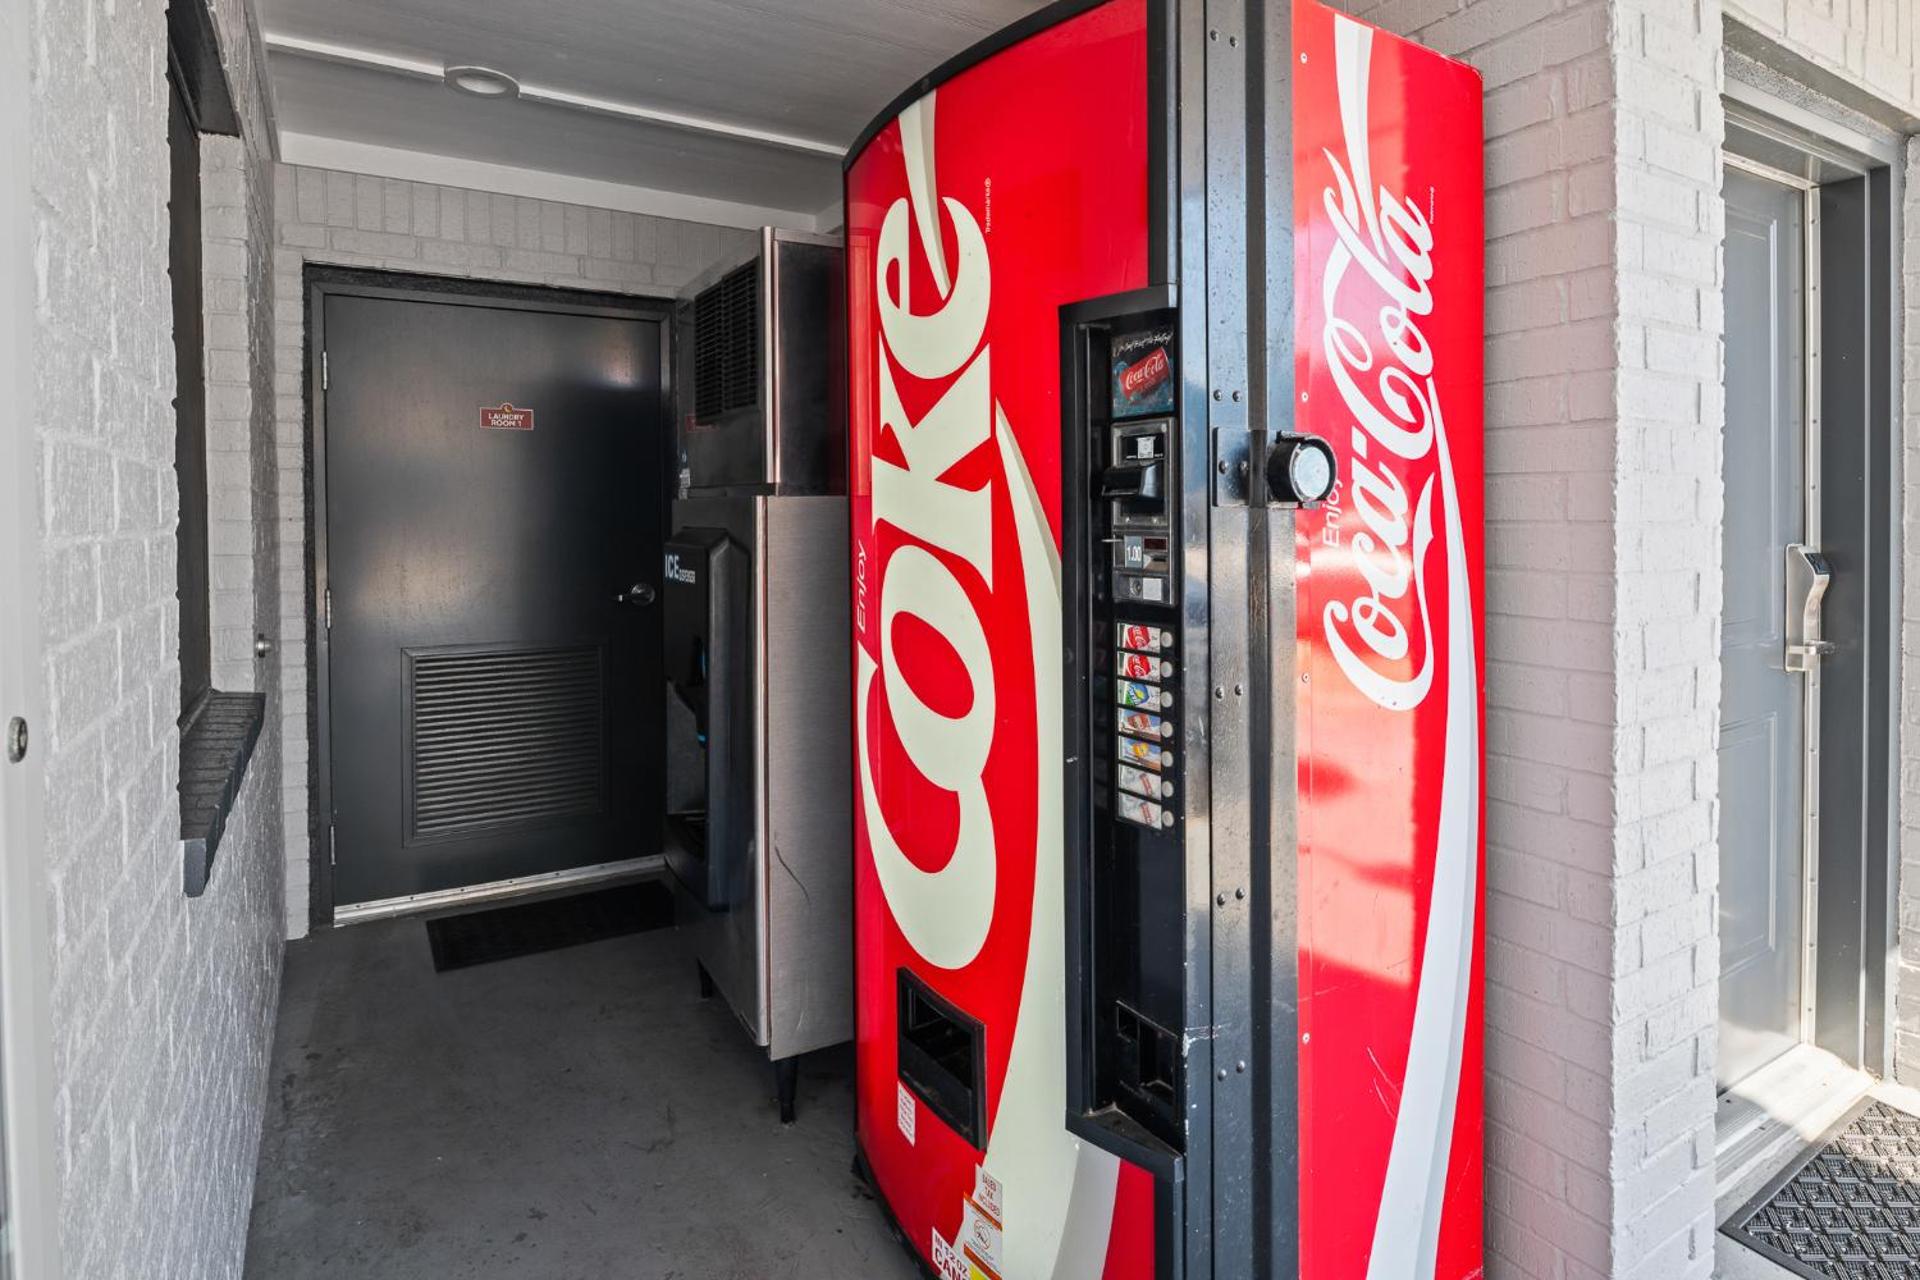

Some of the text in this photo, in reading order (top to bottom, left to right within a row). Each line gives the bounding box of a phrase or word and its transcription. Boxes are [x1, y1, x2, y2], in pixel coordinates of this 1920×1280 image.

[488, 412, 525, 420] LAUNDRY
[491, 419, 516, 427] ROOM
[1323, 147, 1434, 711] Coca-Cola
[664, 554, 679, 579] ICE
[856, 539, 867, 633] Enjoy
[857, 196, 998, 970] Coke
[934, 1233, 943, 1250] IN
[935, 1247, 966, 1280] CAN
